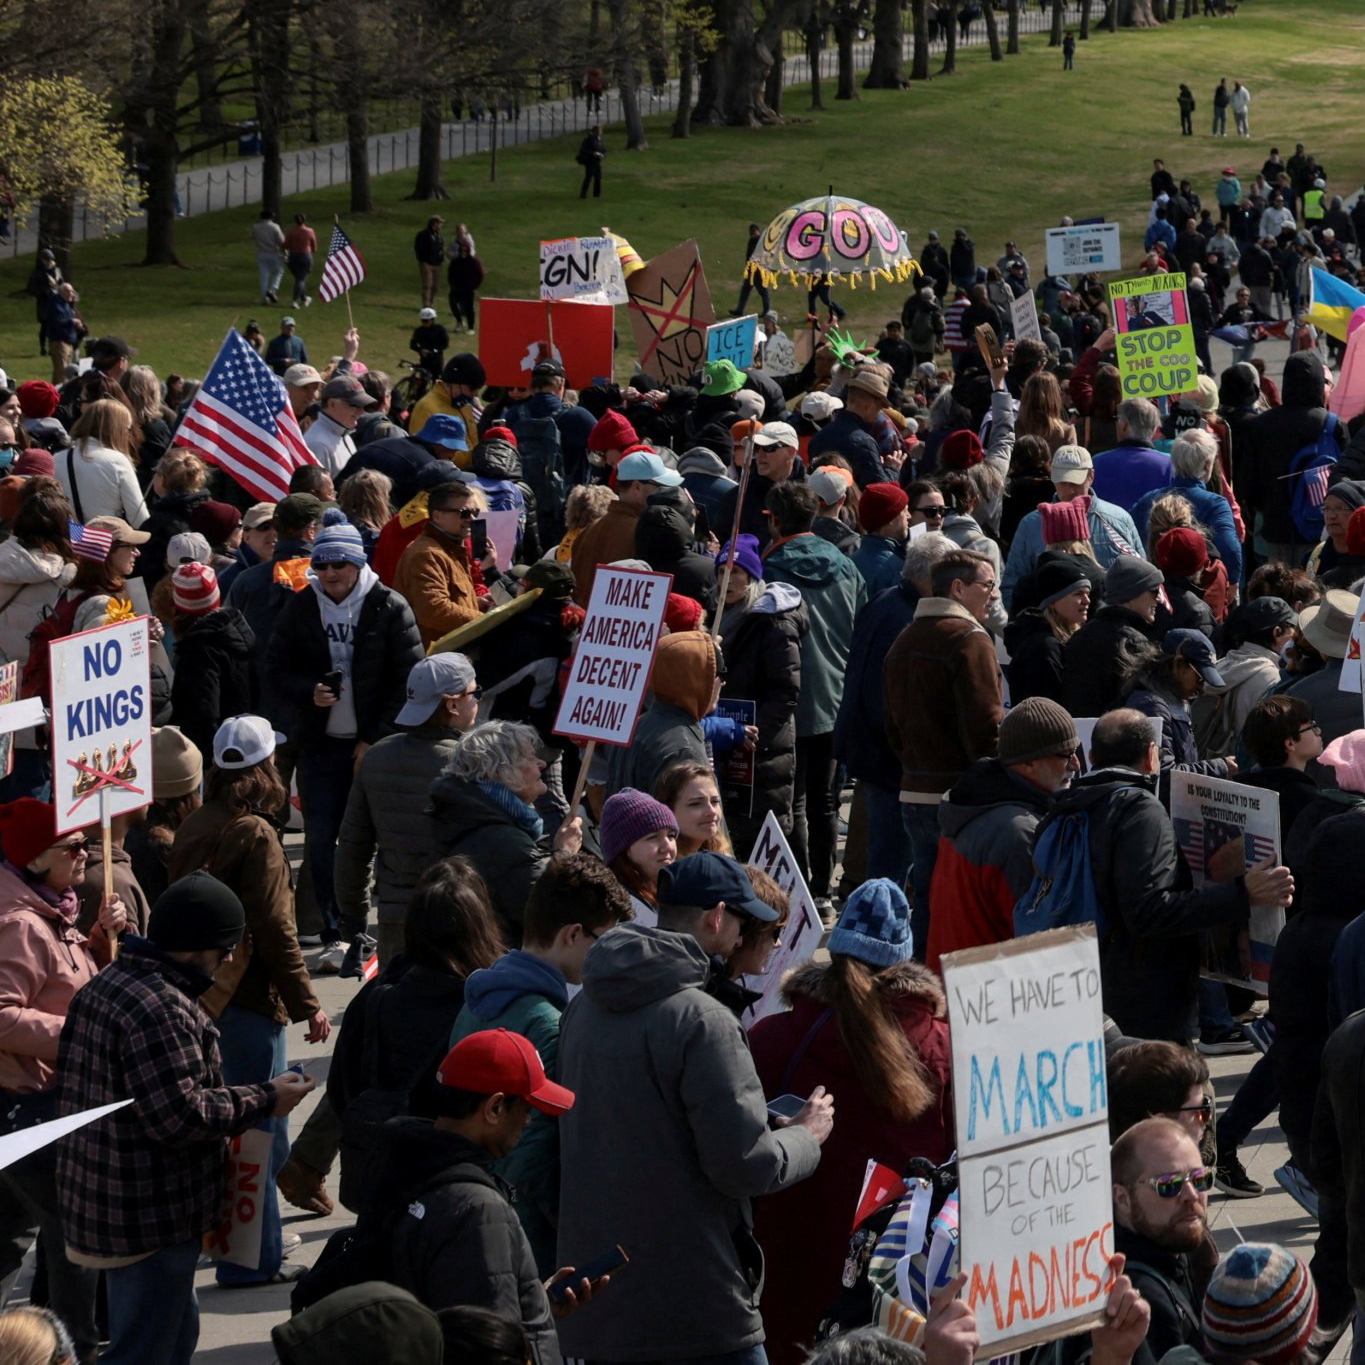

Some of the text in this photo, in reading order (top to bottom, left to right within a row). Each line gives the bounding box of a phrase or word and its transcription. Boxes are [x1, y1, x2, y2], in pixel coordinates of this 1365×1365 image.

[1111, 284, 1123, 295] NO
[655, 329, 704, 376] NO
[715, 325, 744, 353] ICE
[777, 342, 794, 356] NO
[1121, 329, 1183, 357] STOP
[1126, 353, 1191, 372] THE COO
[1123, 367, 1192, 395] COUP
[605, 577, 655, 610] MAKE
[583, 615, 656, 651] AMERICA
[83, 639, 122, 682] NO
[576, 655, 642, 691] DECENT
[66, 684, 144, 741] KINGS
[569, 695, 628, 732] AGAIN!
[1187, 783, 1261, 811] IS YOUR LOYALTY TO THE
[1200, 804, 1247, 825] CONSTITUTION?
[956, 967, 1100, 1026] WE HAVE TO
[968, 1038, 1107, 1142] MARCH
[982, 1144, 1101, 1217] BECAUSE
[1010, 1202, 1076, 1236] OF THE
[967, 1222, 1117, 1331] MADNESS
